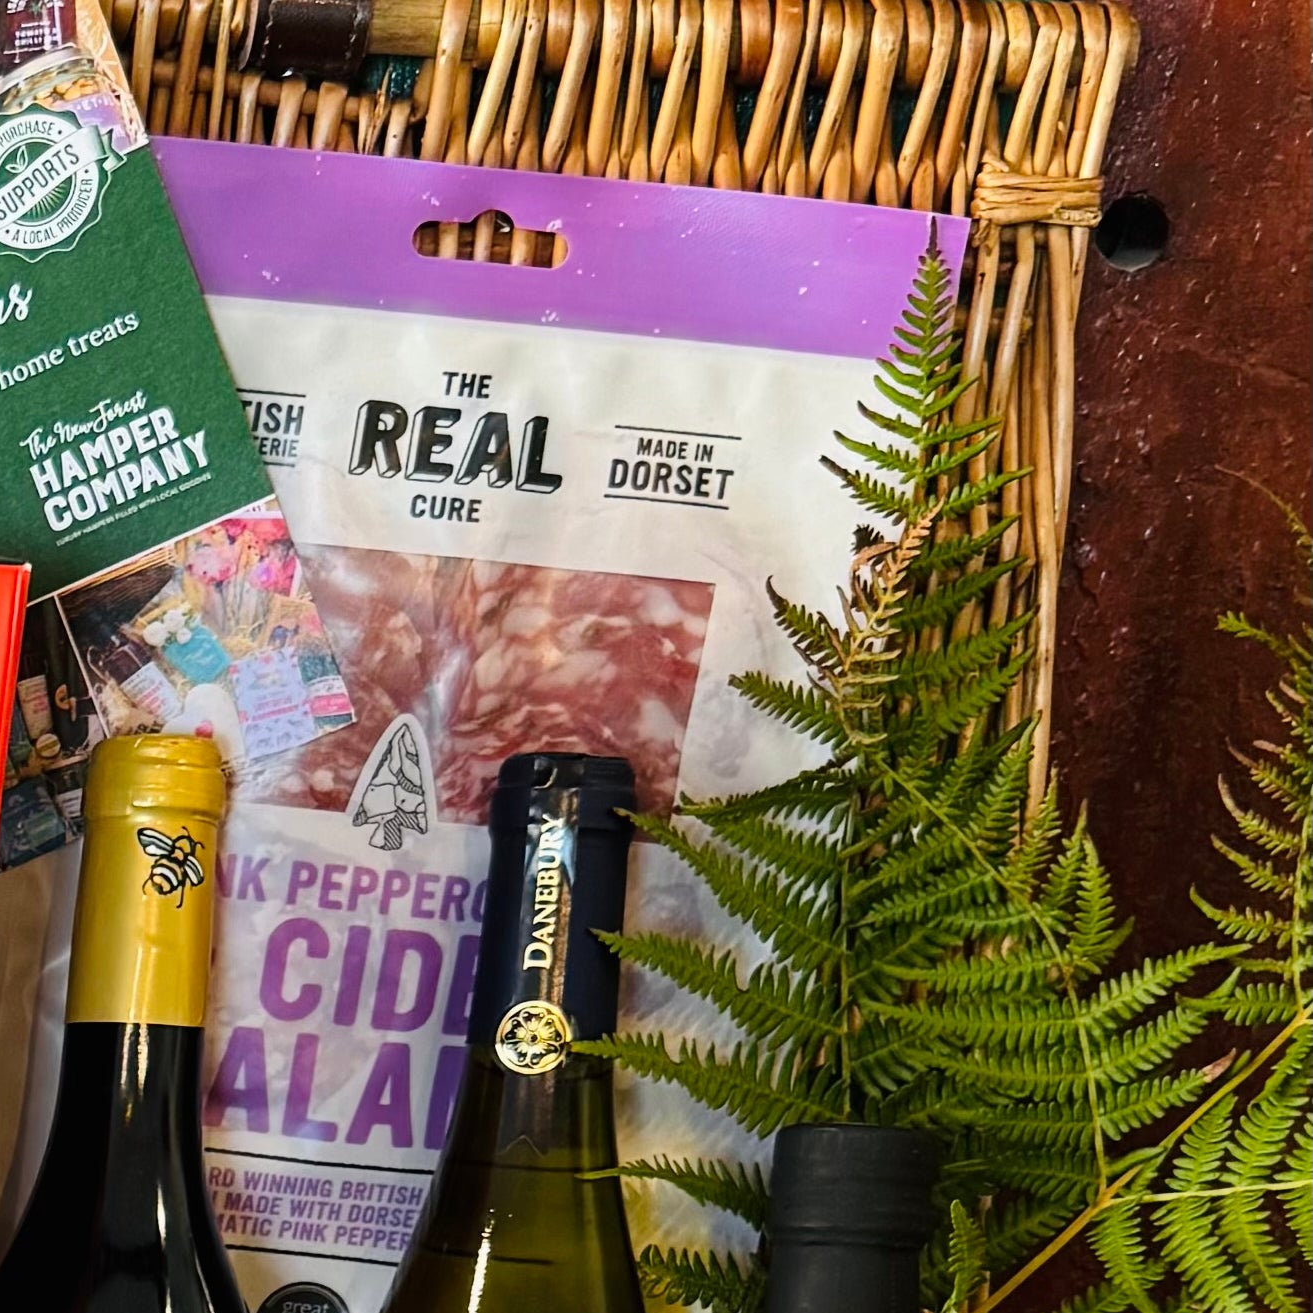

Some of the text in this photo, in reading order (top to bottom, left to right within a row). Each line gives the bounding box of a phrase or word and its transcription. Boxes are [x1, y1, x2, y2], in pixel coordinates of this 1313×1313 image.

[66, 312, 140, 356] treats
[442, 371, 492, 400] THE
[29, 406, 179, 499] HAMPER
[348, 400, 562, 494] REAL
[637, 437, 714, 463] MADE IN
[41, 431, 211, 533] COMPANY
[608, 460, 735, 501] DORSET
[409, 494, 483, 523] CURE
[522, 813, 567, 971] DANEBURY
[244, 1173, 422, 1205] WINNING BRITISH
